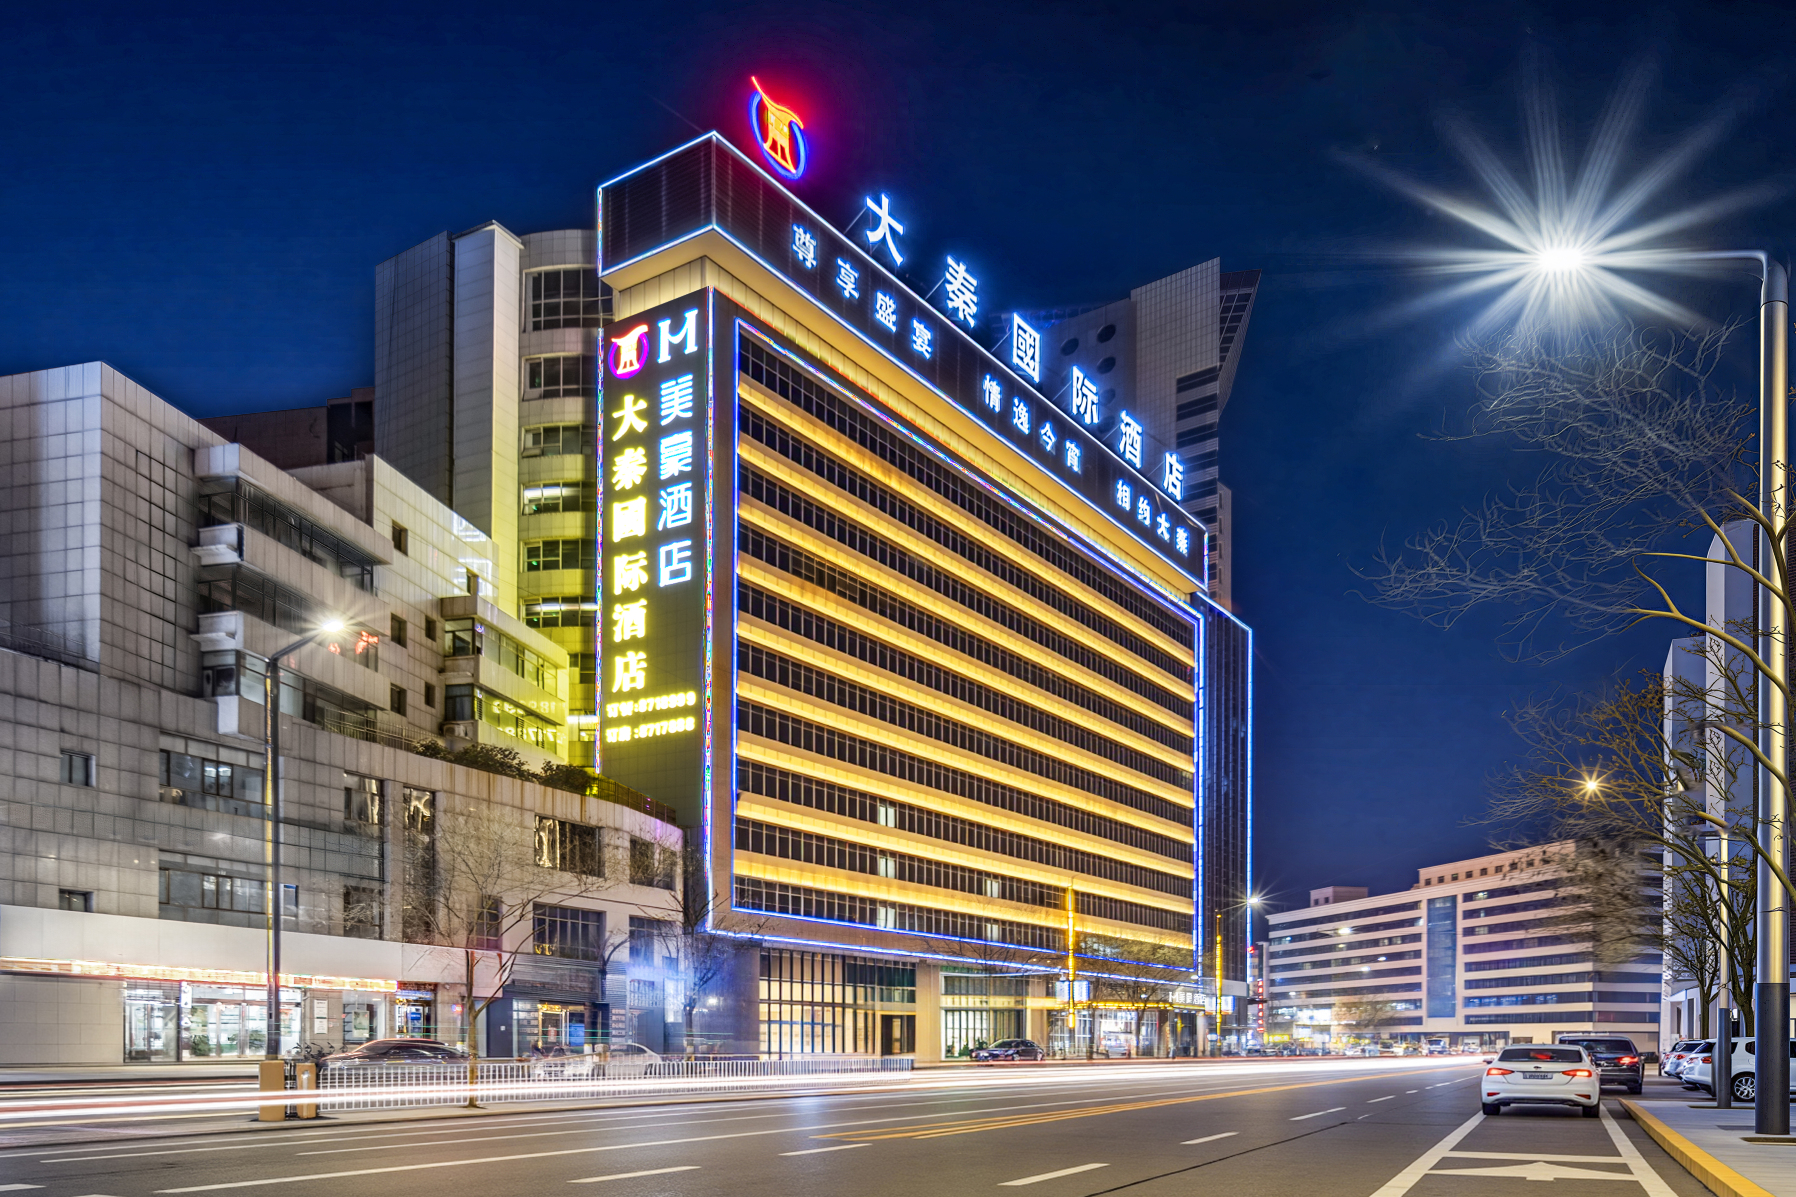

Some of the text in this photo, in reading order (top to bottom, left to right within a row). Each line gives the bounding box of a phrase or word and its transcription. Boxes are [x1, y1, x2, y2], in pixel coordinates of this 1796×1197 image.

[657, 373, 694, 588] 美豪酒店
[791, 223, 1189, 556] 尊享盛宴 情逸今宵 相约大秦
[865, 192, 1185, 501] 大秦國际酒店
[611, 393, 648, 694] 大秦國际酒店
